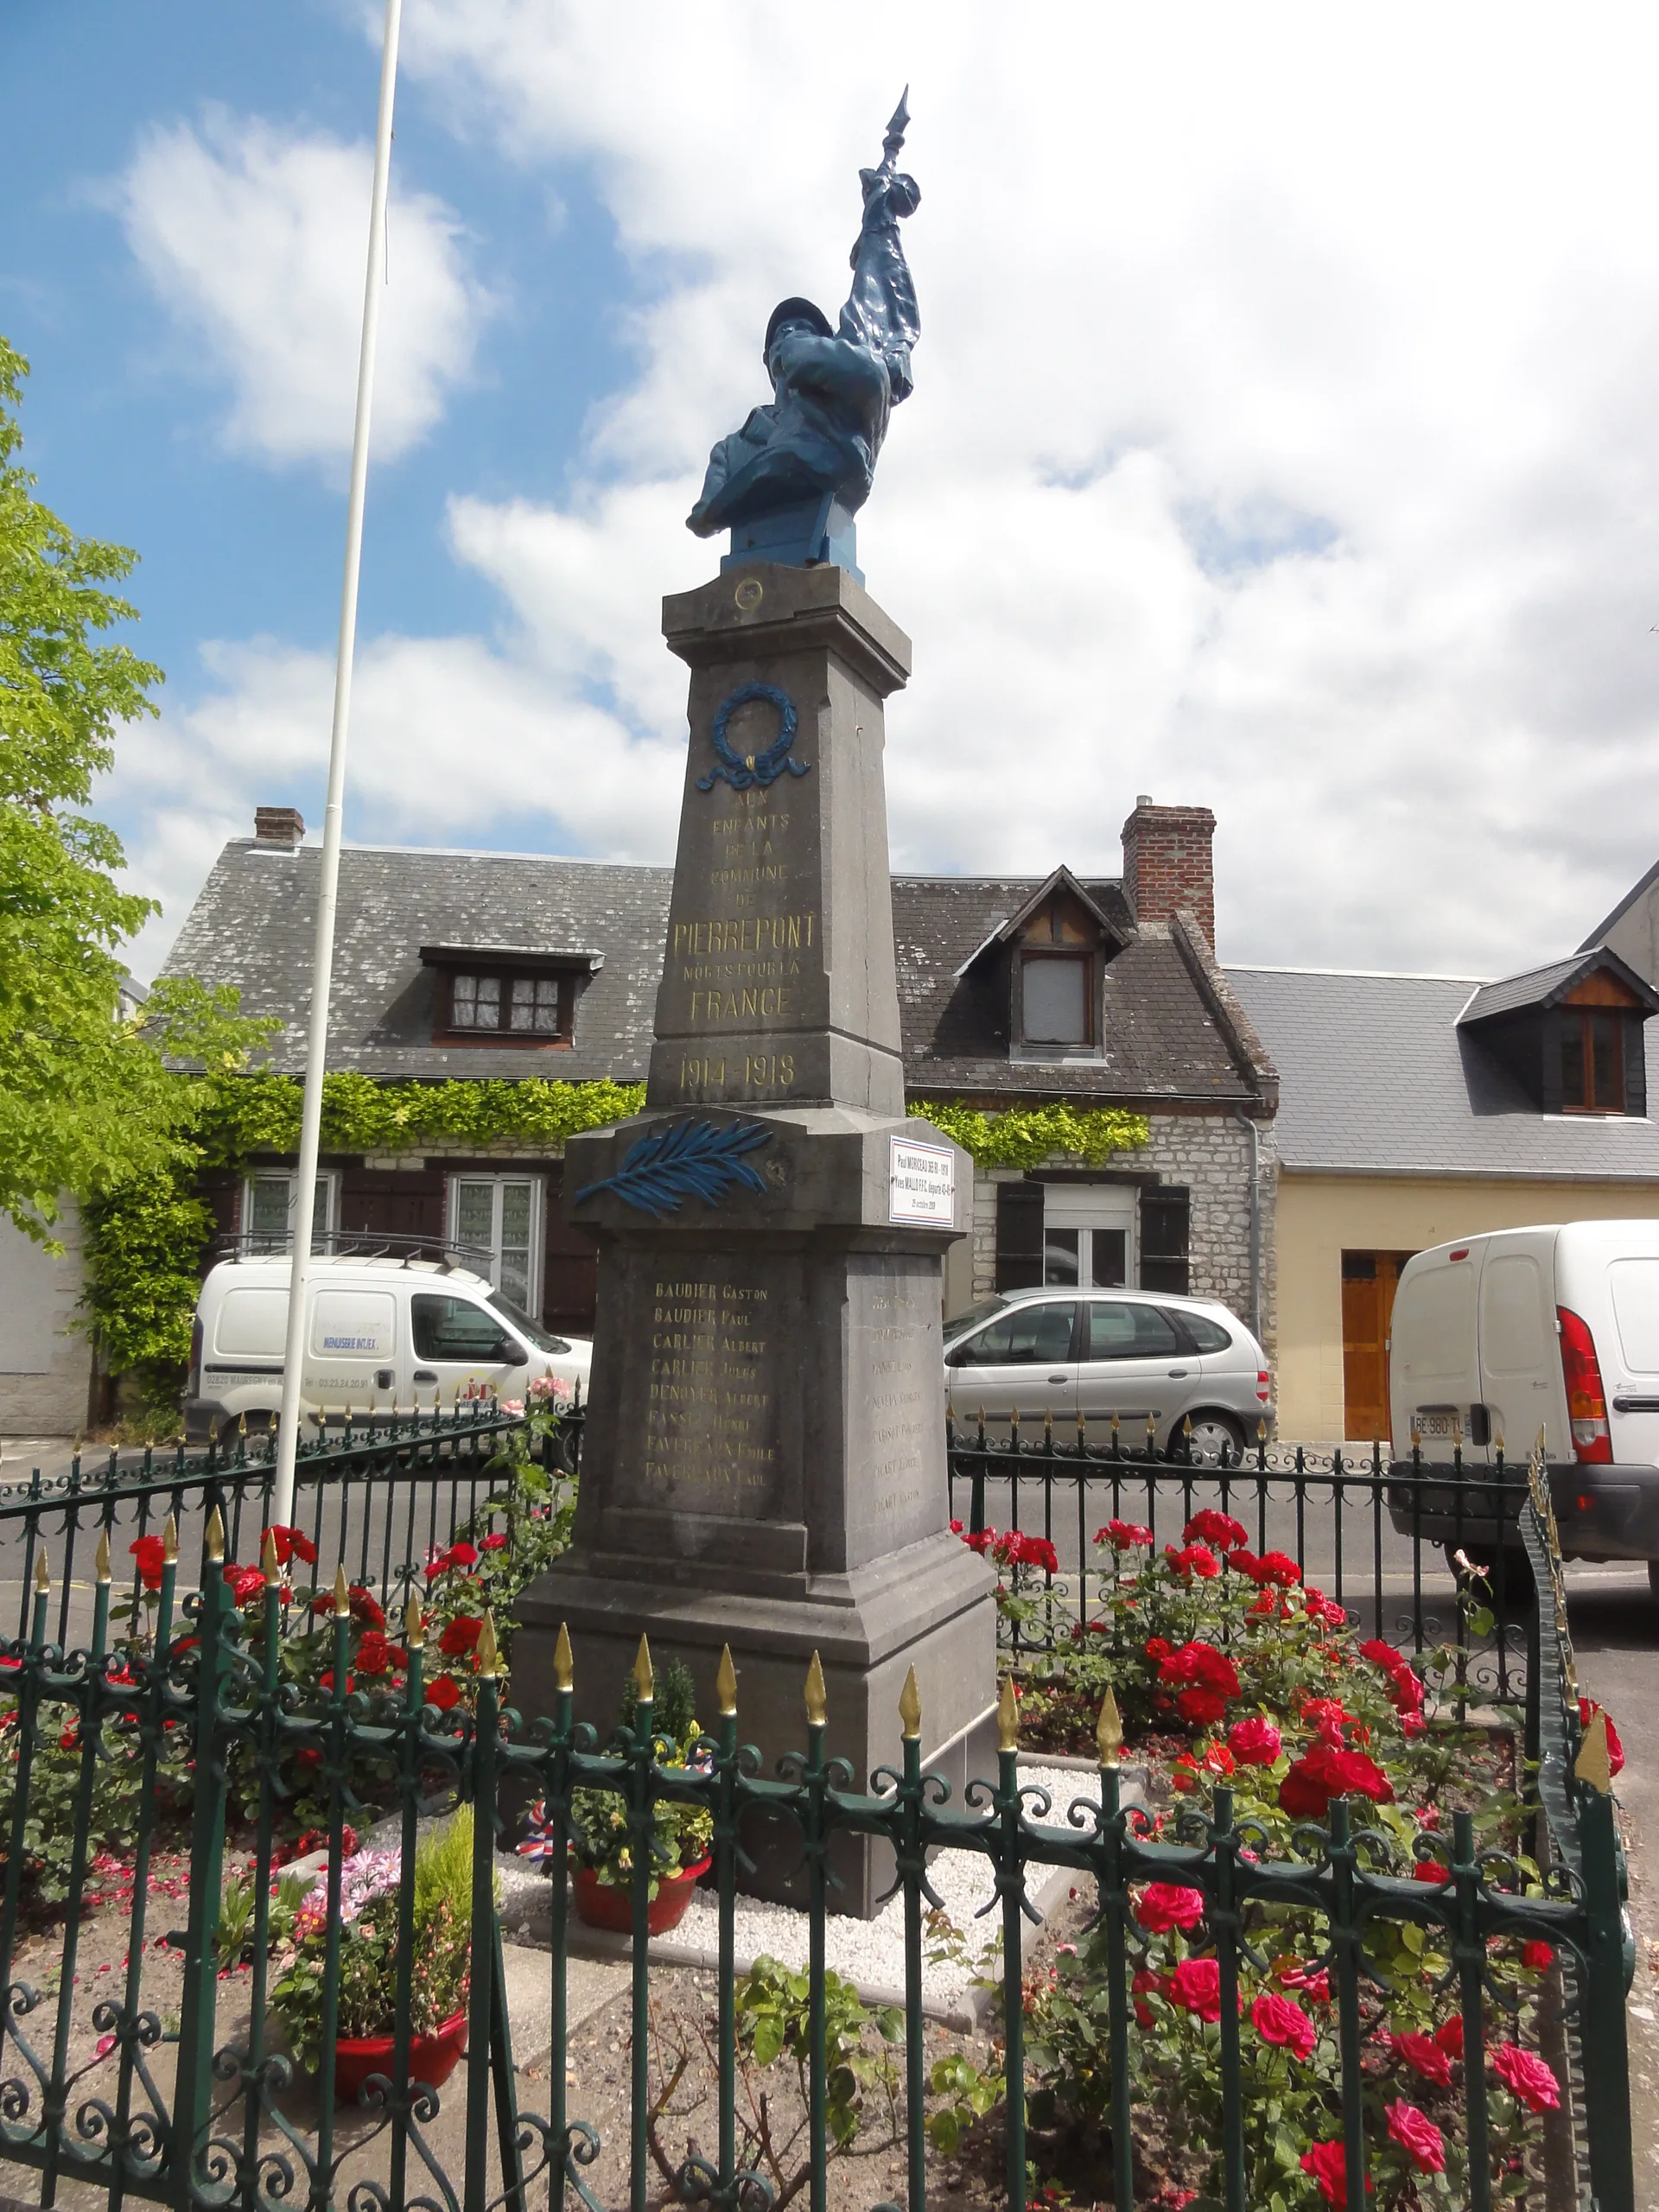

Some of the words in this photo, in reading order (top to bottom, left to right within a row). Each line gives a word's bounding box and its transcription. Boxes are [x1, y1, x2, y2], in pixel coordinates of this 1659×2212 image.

[735, 790, 768, 810] AUX
[713, 813, 790, 835] ENFANTS
[726, 842, 745, 859] DE
[752, 840, 773, 856] LA
[711, 864, 789, 883] COMMUNE
[736, 892, 756, 907] DE
[674, 912, 817, 956] PIERREPONT
[683, 962, 734, 982] MORTS
[738, 960, 776, 978] POUR
[779, 958, 800, 976] LA
[690, 987, 792, 1020] FRANCE
[898, 1154, 906, 1168] Paul
[894, 1175, 905, 1189] Yves
[655, 1282, 716, 1300] BAUDIER
[654, 1307, 715, 1325] BAUDIER
[323, 1337, 355, 1349] MENUISERIE
[653, 1333, 715, 1351] CARLIER
[652, 1358, 714, 1376] CARLIER
